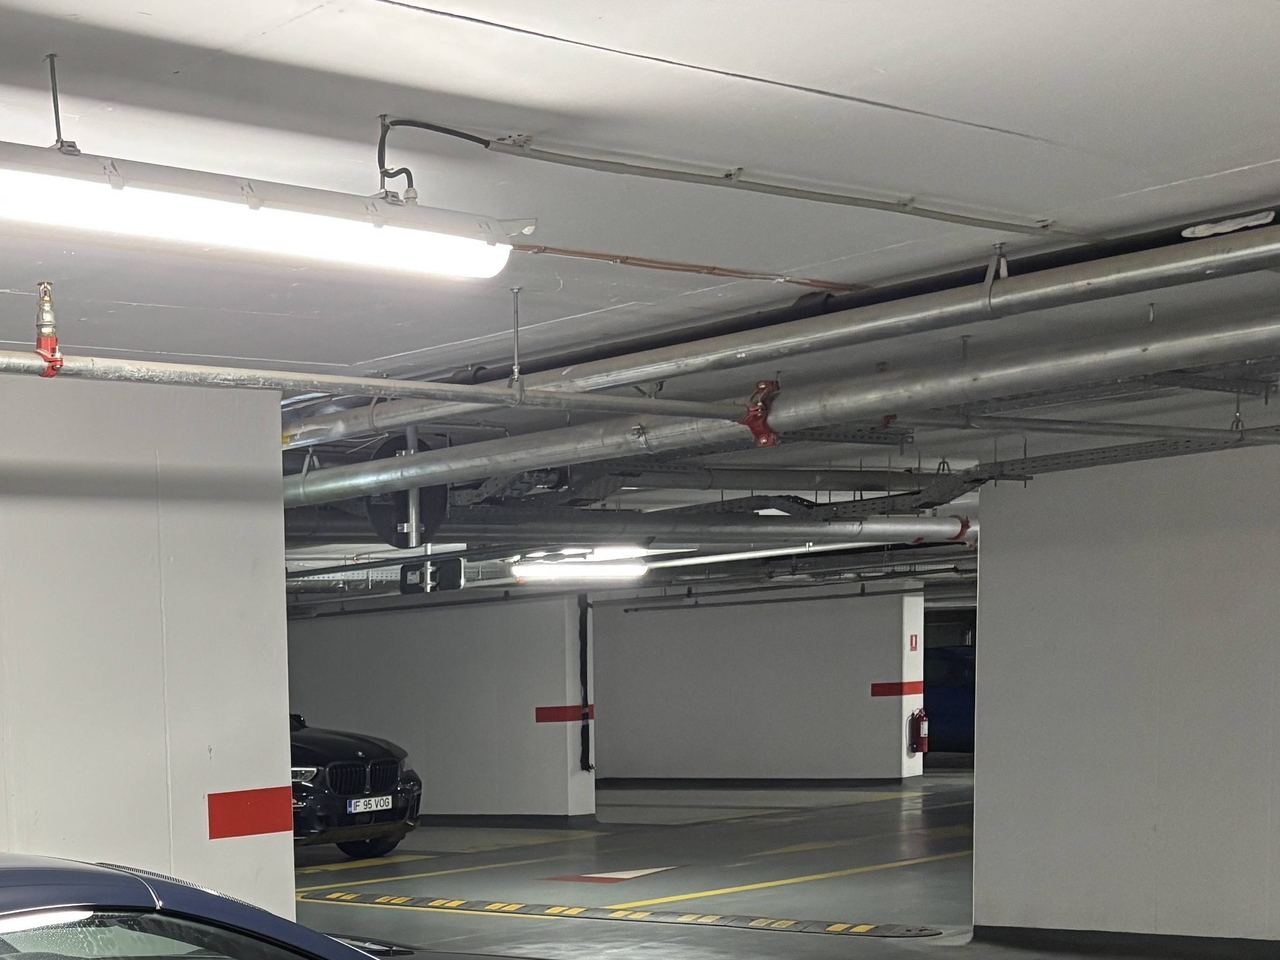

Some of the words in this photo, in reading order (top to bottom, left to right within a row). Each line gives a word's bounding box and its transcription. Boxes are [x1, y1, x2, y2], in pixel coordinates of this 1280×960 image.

[353, 801, 361, 811] IF
[363, 800, 373, 810] 95
[374, 797, 390, 808] VOG
